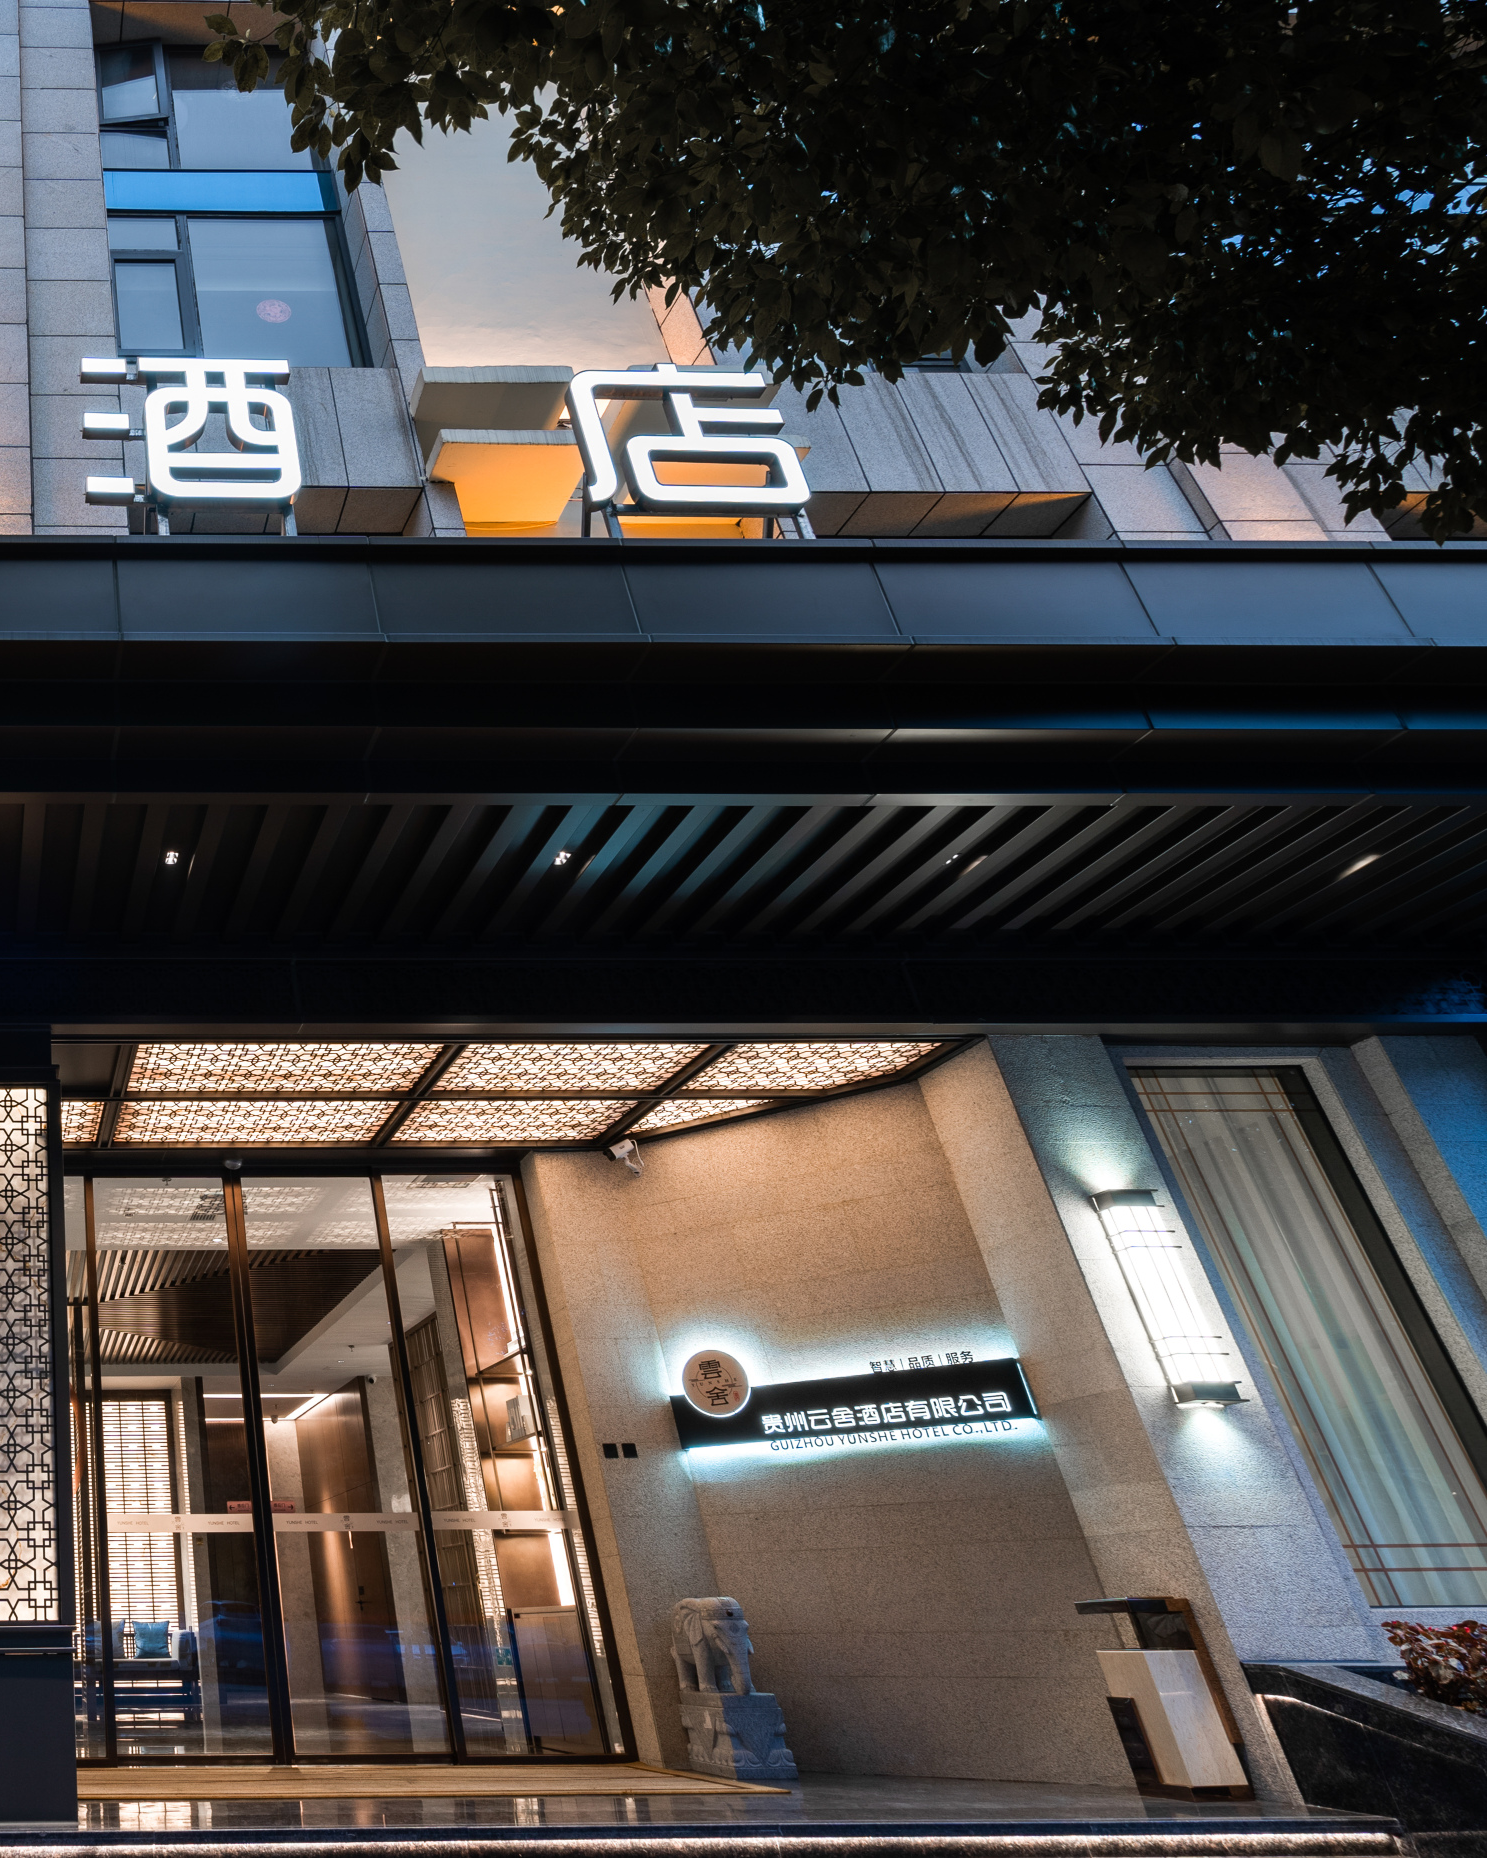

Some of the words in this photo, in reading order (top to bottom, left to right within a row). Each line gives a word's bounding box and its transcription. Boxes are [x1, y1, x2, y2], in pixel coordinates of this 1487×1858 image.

[907, 1354, 936, 1370] 品质
[945, 1350, 974, 1365] 服务
[761, 1391, 1012, 1435] 贵州云舍酒店有限公司
[770, 1437, 834, 1451] GUIZHOU
[837, 1431, 898, 1446] YUNSHE
[900, 1426, 950, 1440] HOTEL
